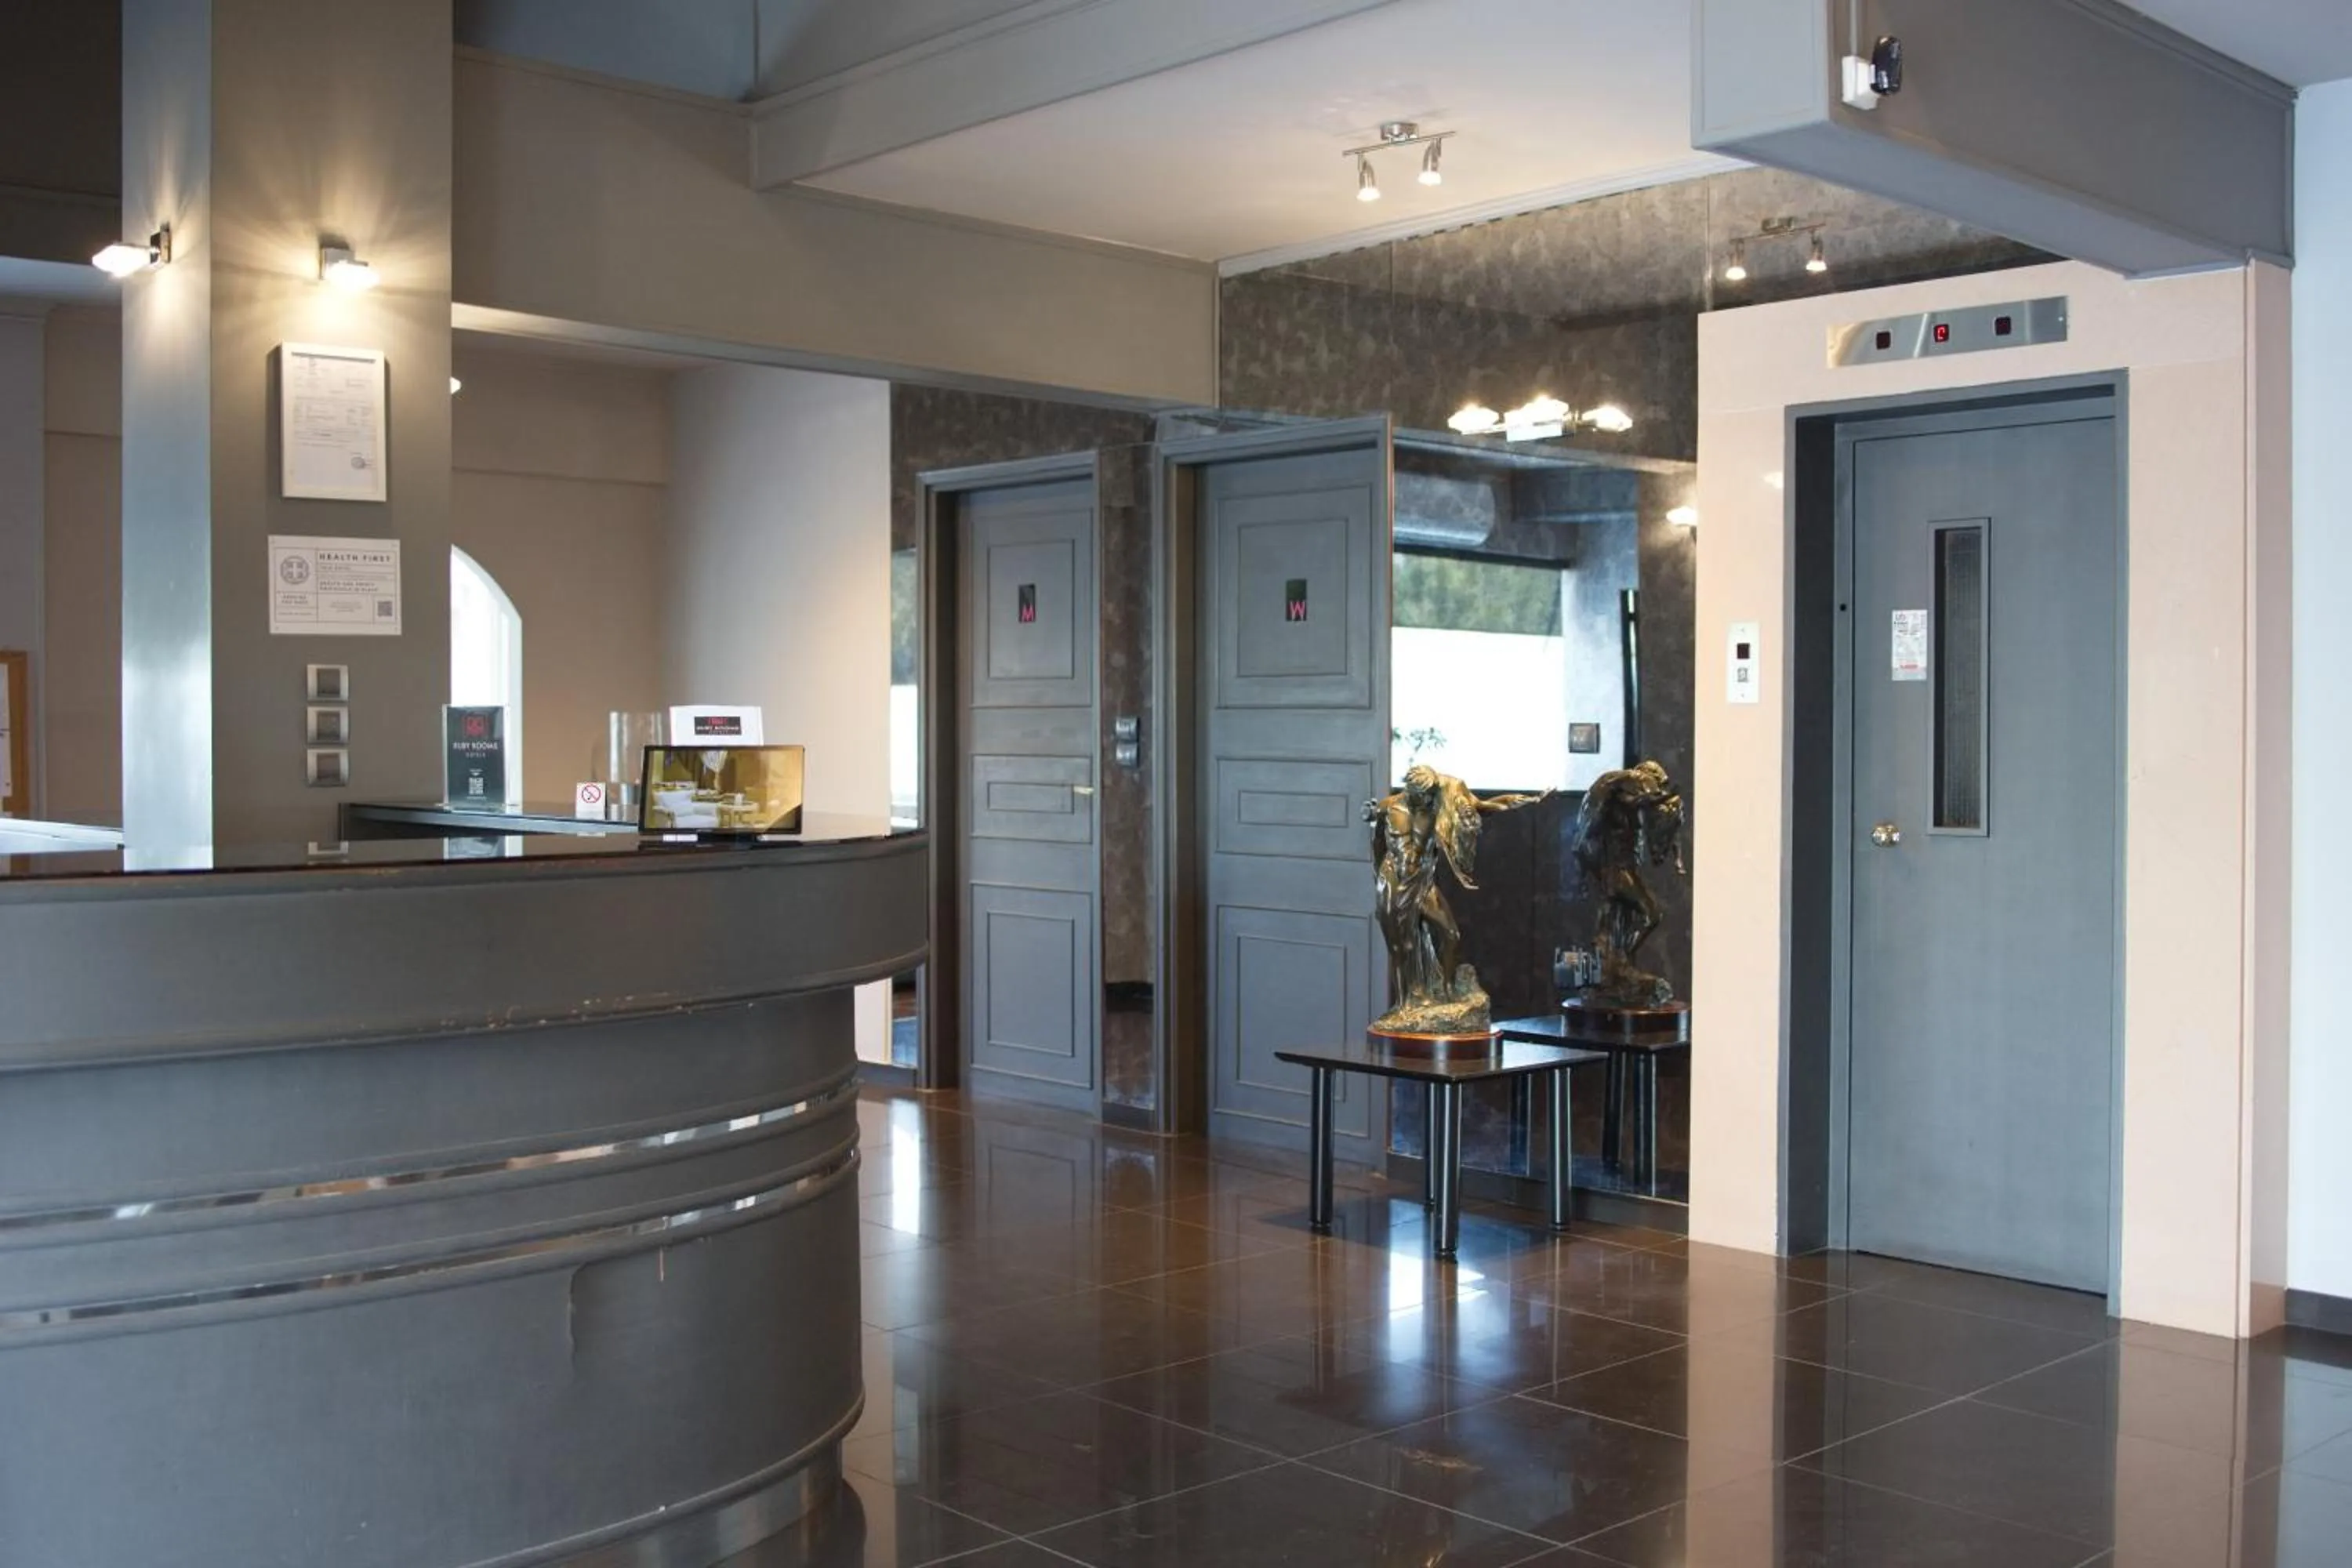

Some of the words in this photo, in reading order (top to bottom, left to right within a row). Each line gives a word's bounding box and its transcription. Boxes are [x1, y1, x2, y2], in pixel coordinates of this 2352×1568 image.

[319, 553, 358, 562] HEALTH
[363, 554, 390, 563] FIRST
[1022, 602, 1034, 622] M
[1290, 600, 1305, 621] W
